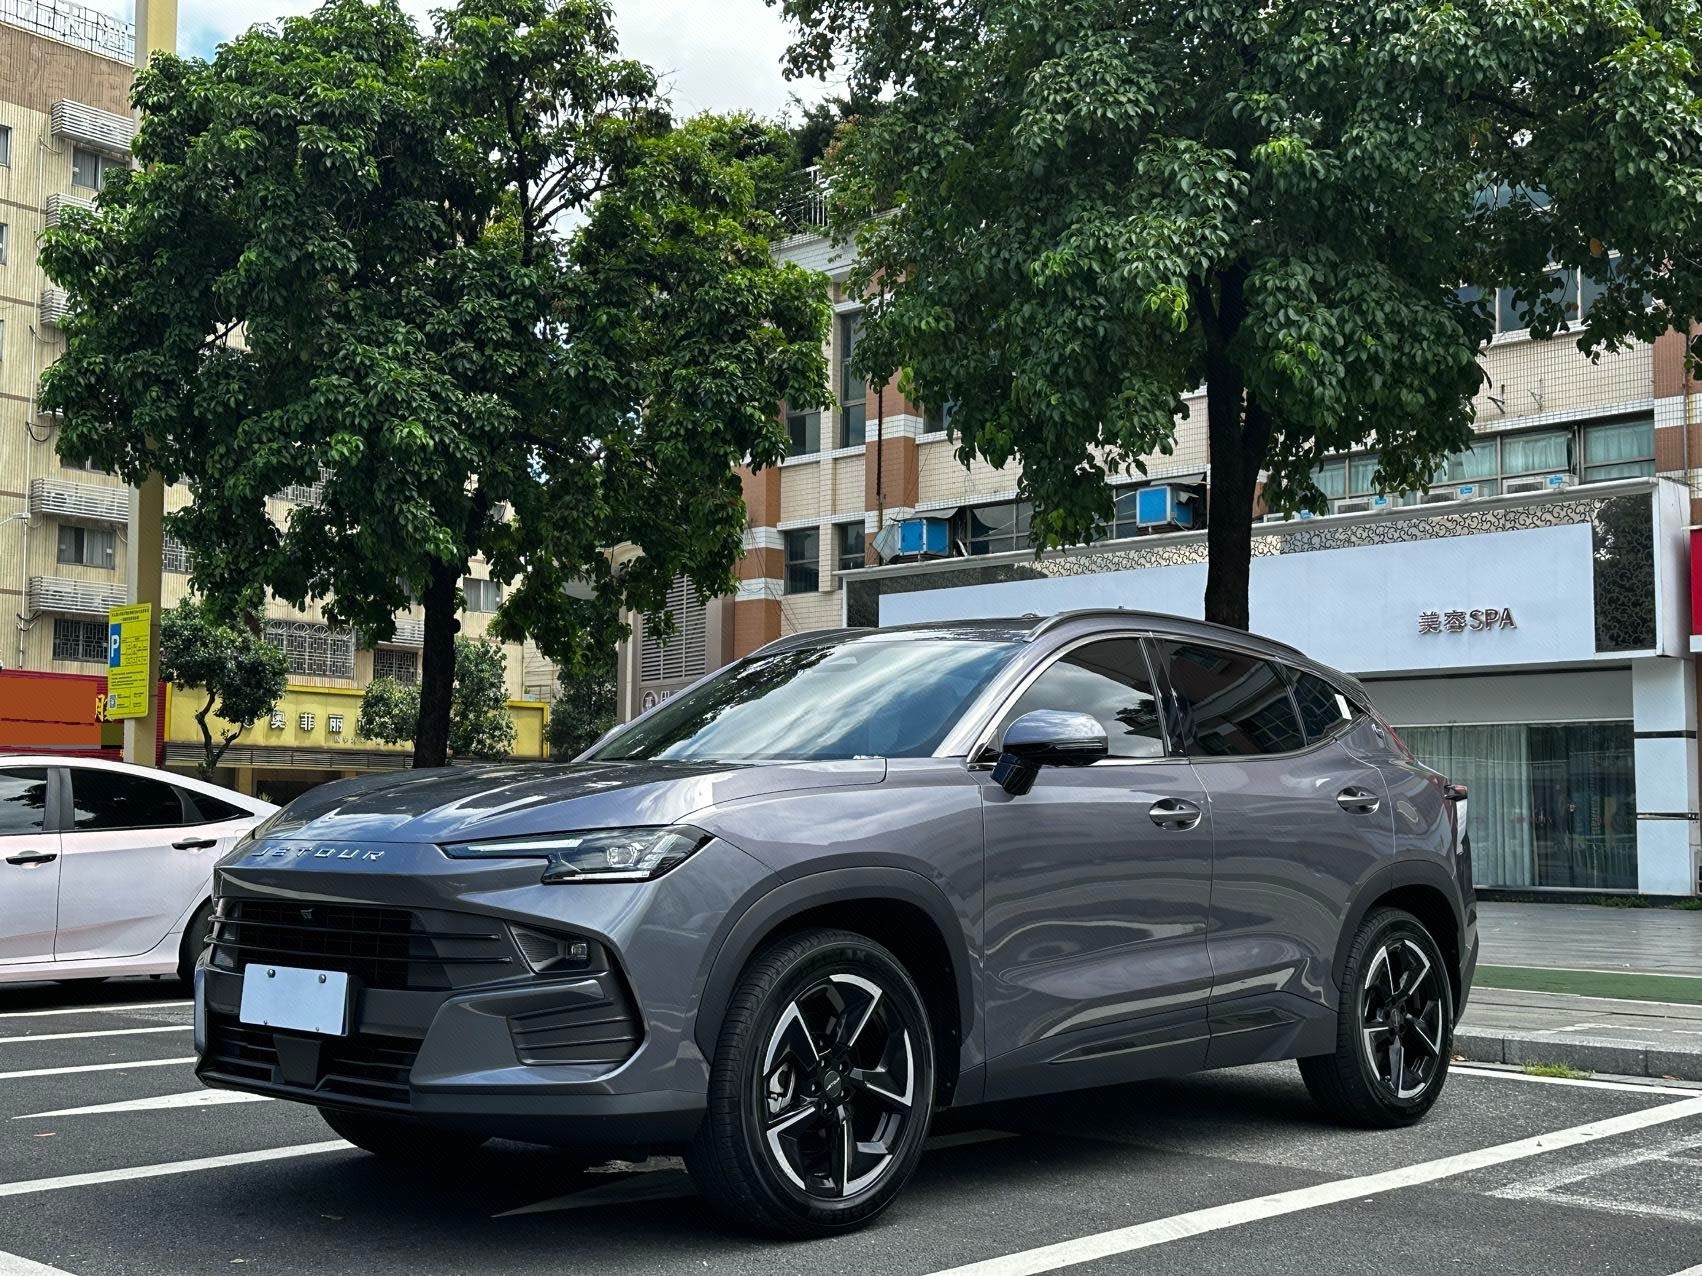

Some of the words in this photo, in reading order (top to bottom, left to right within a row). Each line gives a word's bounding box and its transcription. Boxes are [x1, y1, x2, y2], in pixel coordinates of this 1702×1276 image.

[1418, 607, 1517, 634] 美容SPA
[111, 635, 120, 657] P
[271, 710, 363, 734] 奥菲丽
[251, 846, 385, 861] JETOUR
